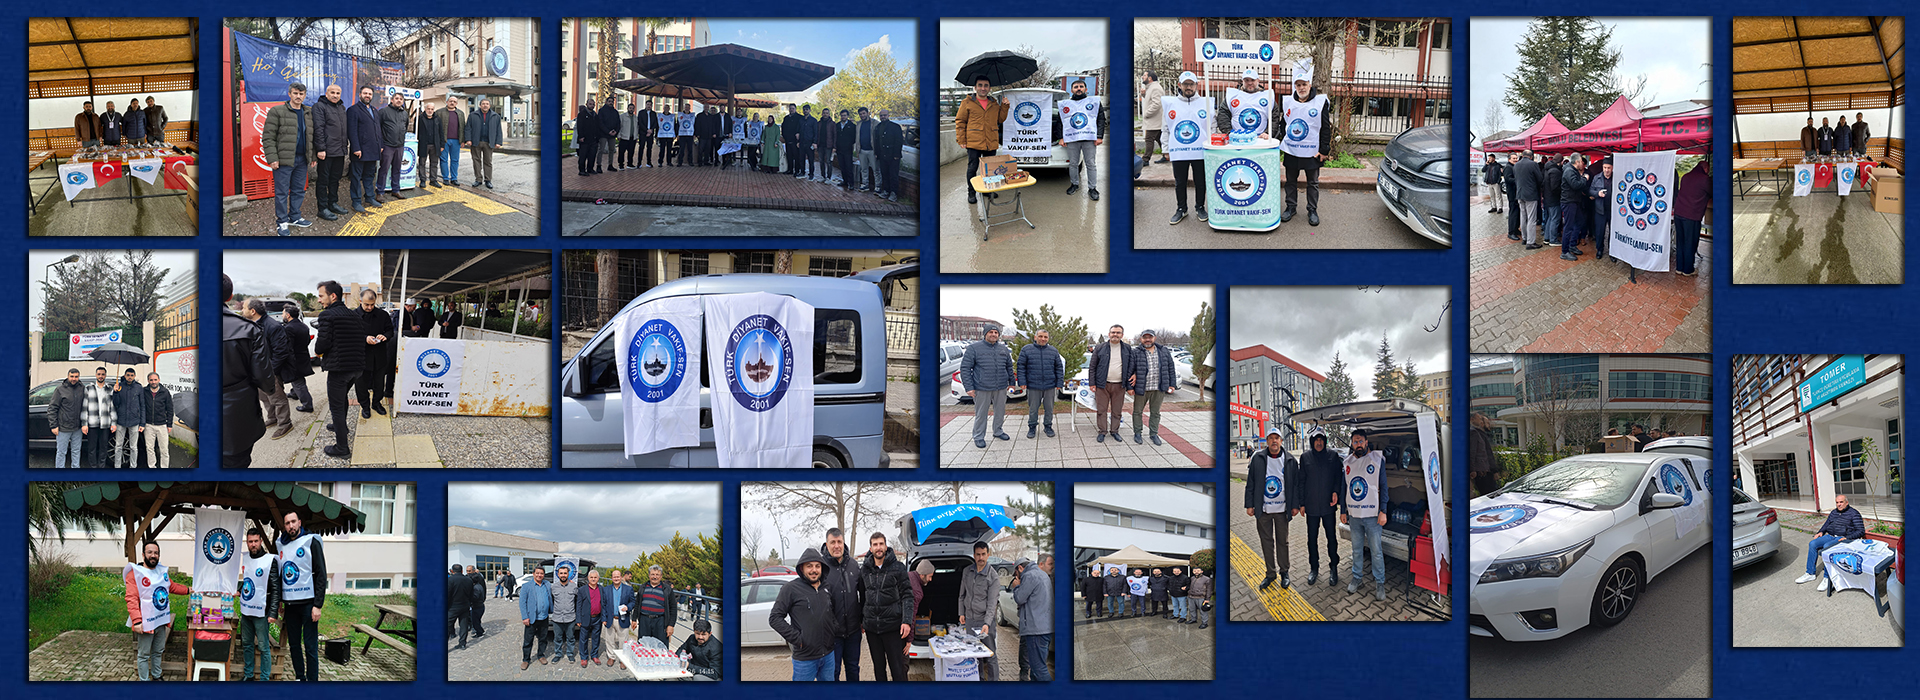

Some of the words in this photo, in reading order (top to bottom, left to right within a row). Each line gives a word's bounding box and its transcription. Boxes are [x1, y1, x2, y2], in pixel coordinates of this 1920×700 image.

[1568, 127, 1623, 143] BELEDİYESİ
[1217, 159, 1247, 175] DİYANET
[634, 323, 663, 348] DİYANET
[667, 328, 685, 378] VAKIF-SEN
[725, 350, 735, 385] TÜRK
[731, 317, 768, 343] DİYANET
[773, 323, 792, 383] VAKIF-SEN
[419, 381, 445, 389] TÜRK
[411, 390, 450, 398] DİYANET
[647, 389, 664, 399] 2001
[406, 399, 453, 407] VAKIF-SEN
[750, 399, 770, 410] 2001
